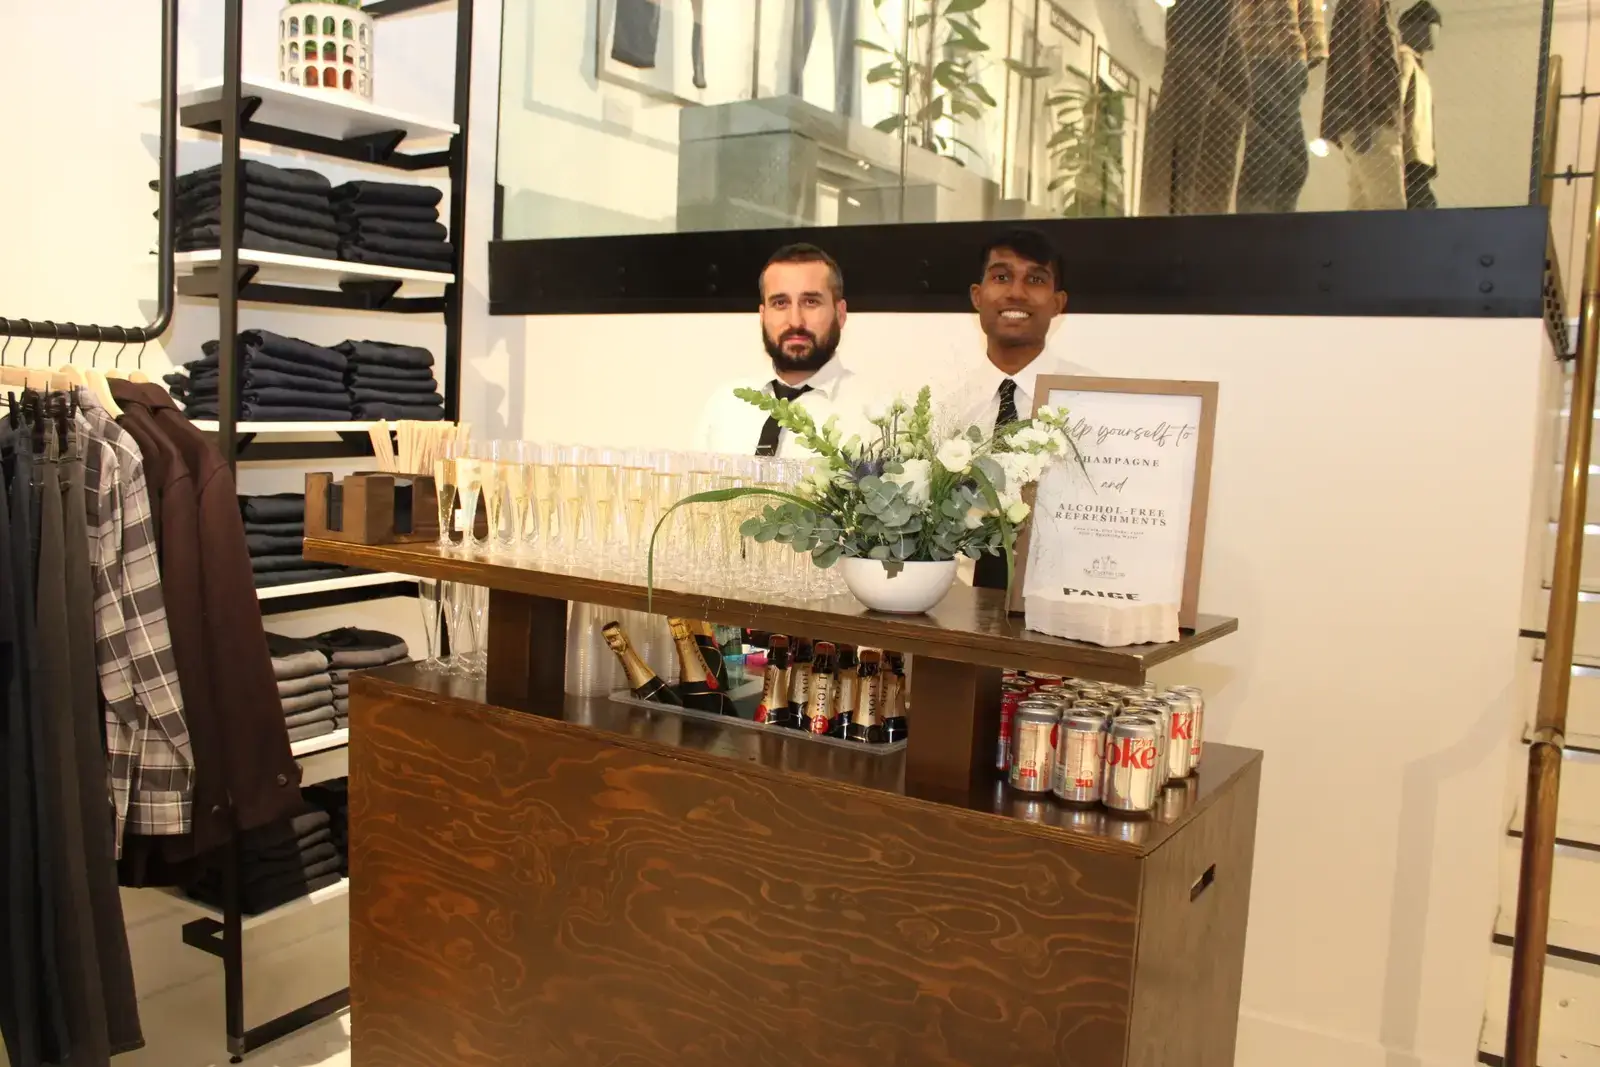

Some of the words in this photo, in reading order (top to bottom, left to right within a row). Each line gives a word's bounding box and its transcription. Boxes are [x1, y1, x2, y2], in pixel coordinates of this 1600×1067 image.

[1061, 416, 1093, 440] elp
[1097, 421, 1172, 447] yourself
[1172, 423, 1196, 447] to
[1073, 456, 1160, 467] CHAMPAGNE
[1100, 477, 1129, 493] and
[1059, 503, 1165, 517] ALCOHOL-FREE
[1055, 511, 1167, 526] REFRESHMENTS
[1063, 587, 1141, 601] PAIGE
[1106, 737, 1157, 770] oke
